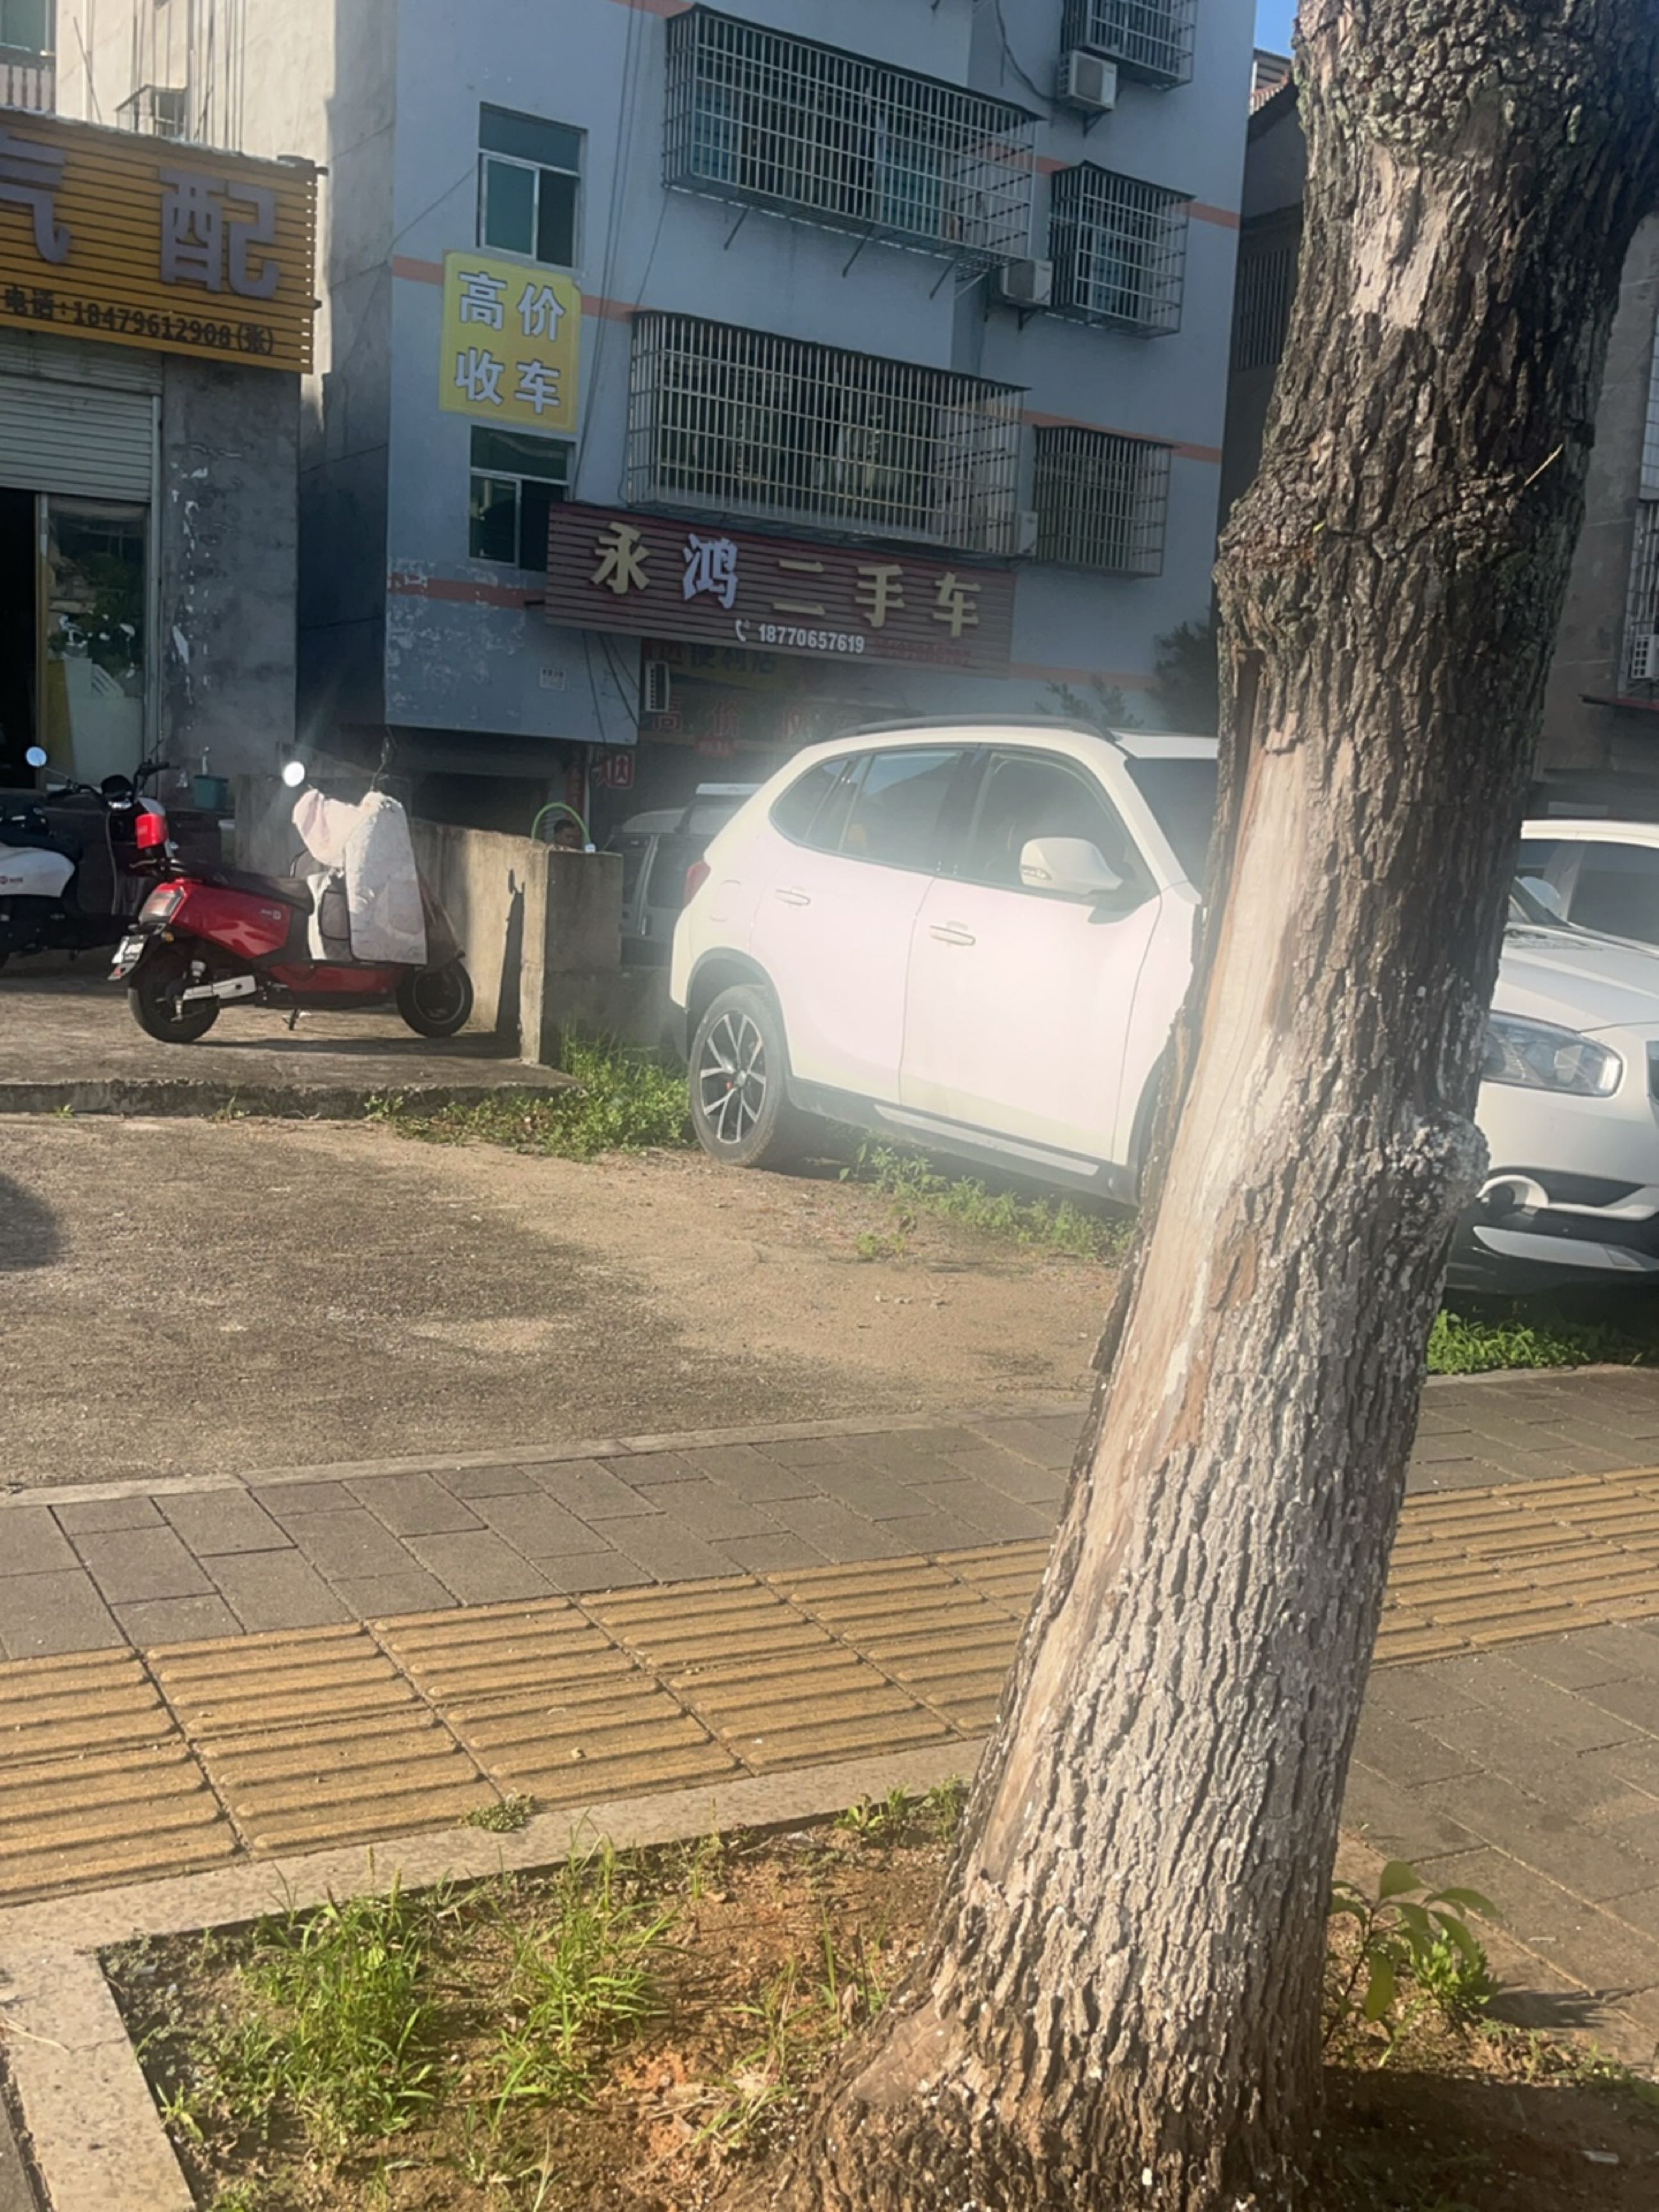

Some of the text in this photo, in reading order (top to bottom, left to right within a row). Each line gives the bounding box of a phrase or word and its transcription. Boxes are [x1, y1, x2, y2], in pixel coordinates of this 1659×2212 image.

[457, 271, 566, 342] 高价
[454, 346, 561, 415] 收车
[590, 522, 981, 637] 永鸿二手车
[759, 623, 864, 653] 18770657619
